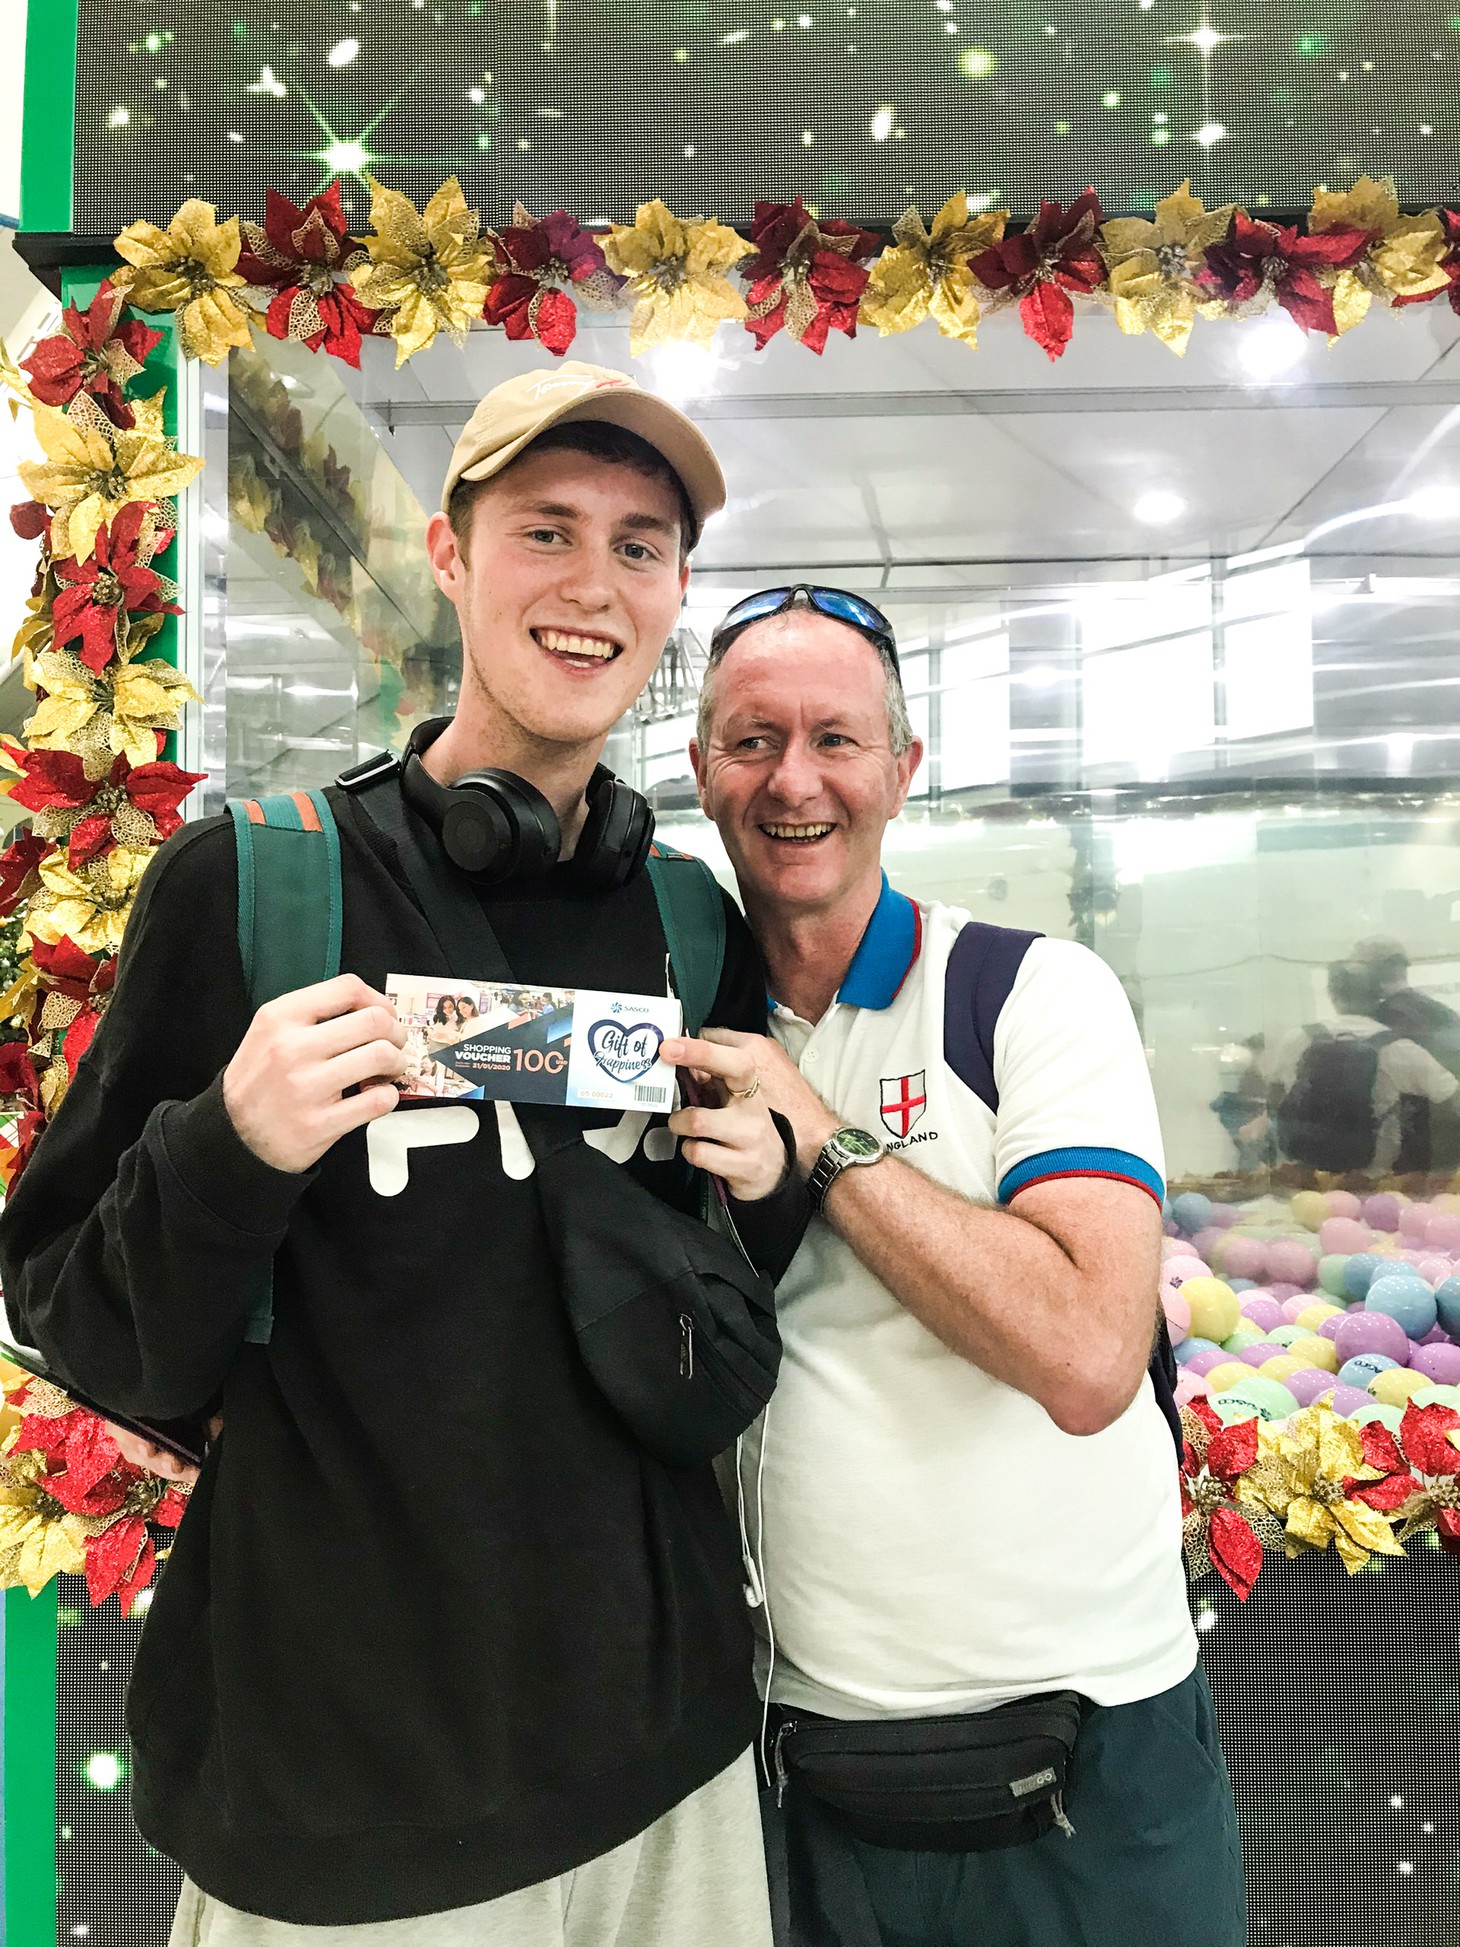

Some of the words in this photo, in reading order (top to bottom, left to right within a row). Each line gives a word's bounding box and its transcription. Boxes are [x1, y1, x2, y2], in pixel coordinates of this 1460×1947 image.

[463, 1043, 512, 1055] SHOPPING
[601, 1029, 629, 1058] Gift
[633, 1033, 648, 1058] of
[454, 1051, 511, 1064] VOUCHER
[513, 1048, 566, 1074] 100
[472, 1063, 511, 1071] 31/01/2020
[885, 1131, 939, 1152] NGLAND
